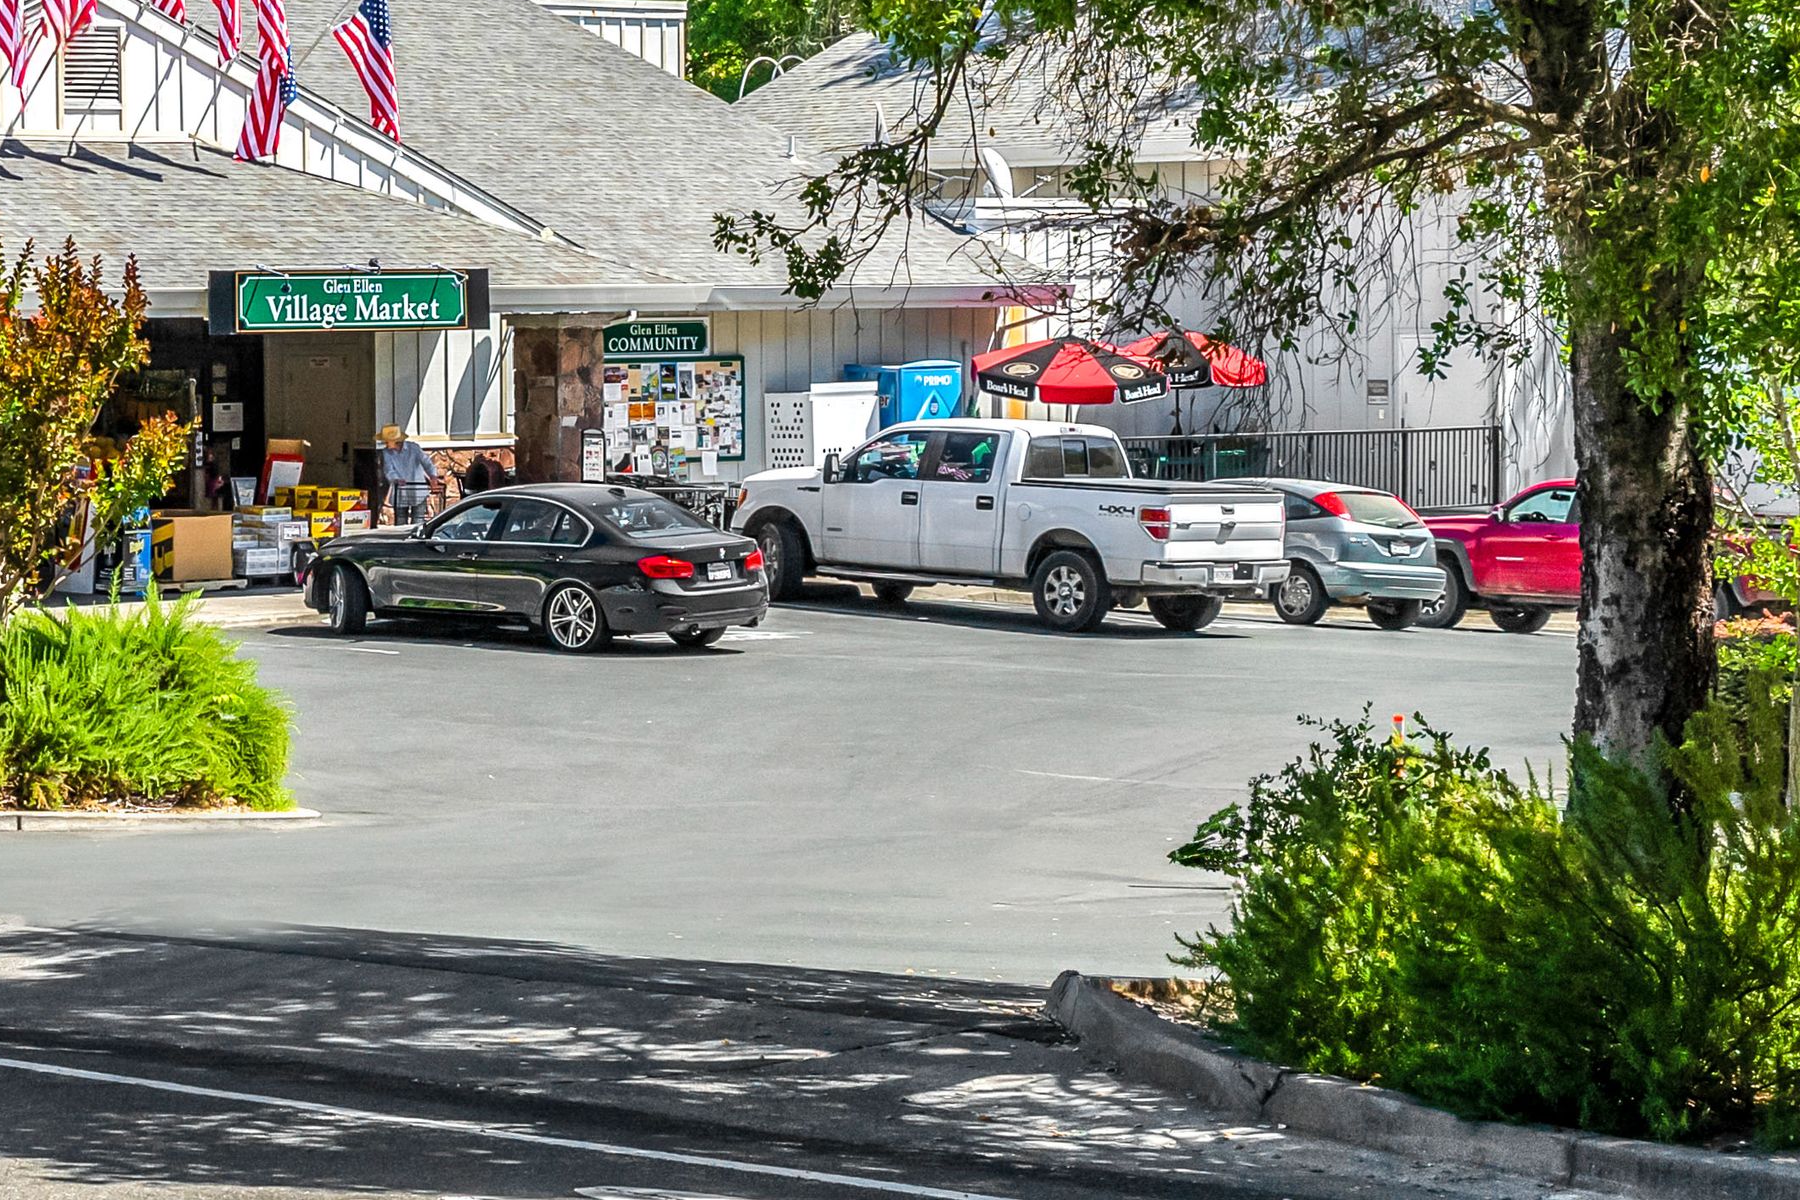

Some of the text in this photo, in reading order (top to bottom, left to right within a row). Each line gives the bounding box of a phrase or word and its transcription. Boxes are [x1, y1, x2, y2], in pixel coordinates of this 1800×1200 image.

[323, 278, 383, 293] Glen Ellen
[265, 294, 440, 328] Village Market
[630, 324, 678, 335] Glen Ellen
[608, 336, 699, 352] COMMUNITY
[924, 375, 951, 386] PRIMO
[1008, 383, 1029, 397] Head
